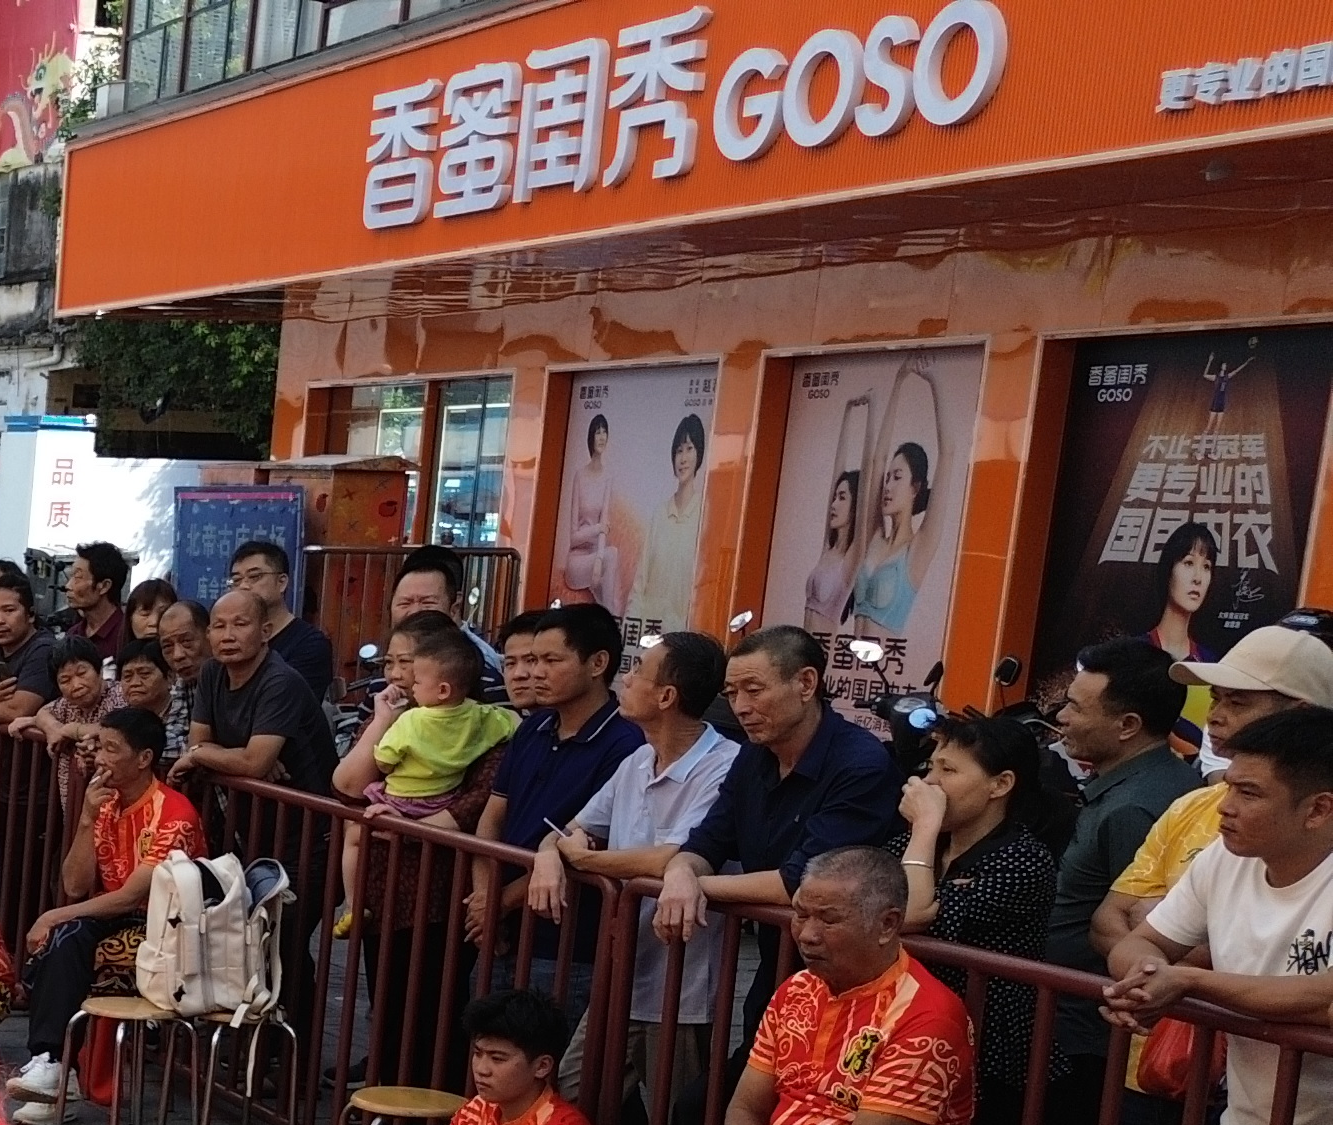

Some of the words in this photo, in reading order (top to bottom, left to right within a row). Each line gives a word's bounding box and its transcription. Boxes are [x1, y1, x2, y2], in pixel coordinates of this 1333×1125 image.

[363, 5, 713, 229] 香蜜闺秀
[713, 0, 1007, 162] GOSO
[1088, 364, 1148, 386] 香蜜闺秀
[1097, 388, 1133, 402] GOSO
[47, 458, 74, 528] 品质
[1123, 462, 1272, 505] 更专业的
